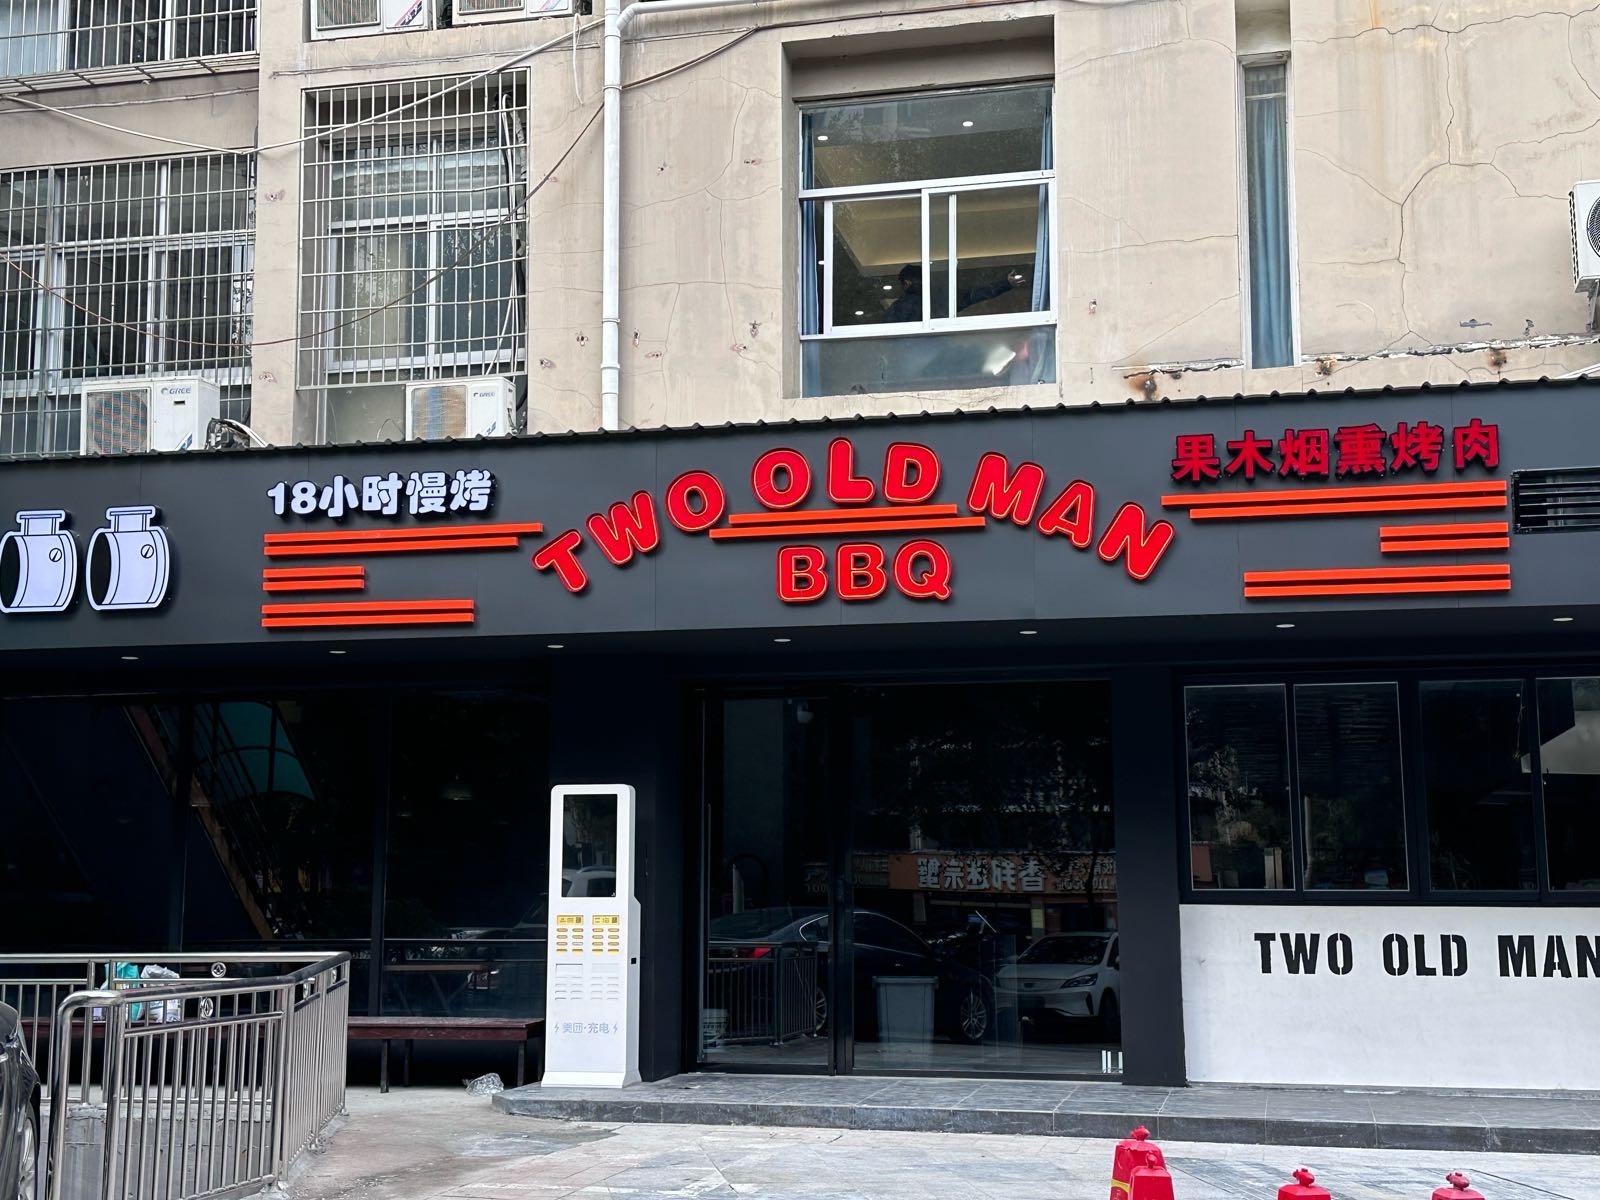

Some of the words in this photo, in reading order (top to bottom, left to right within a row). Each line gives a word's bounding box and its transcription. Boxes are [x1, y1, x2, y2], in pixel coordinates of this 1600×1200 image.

[169, 387, 191, 395] GREE
[1171, 418, 1500, 481] 果木烟熏烤肉
[267, 470, 492, 518] 18小时慢烤
[532, 469, 725, 593] TWO
[751, 437, 941, 509] OLD
[967, 451, 1175, 580] MAN
[777, 539, 952, 603] BBQ
[1254, 932, 1353, 975] TWO
[1382, 933, 1468, 977] OLD
[1497, 935, 1600, 978] MAN
